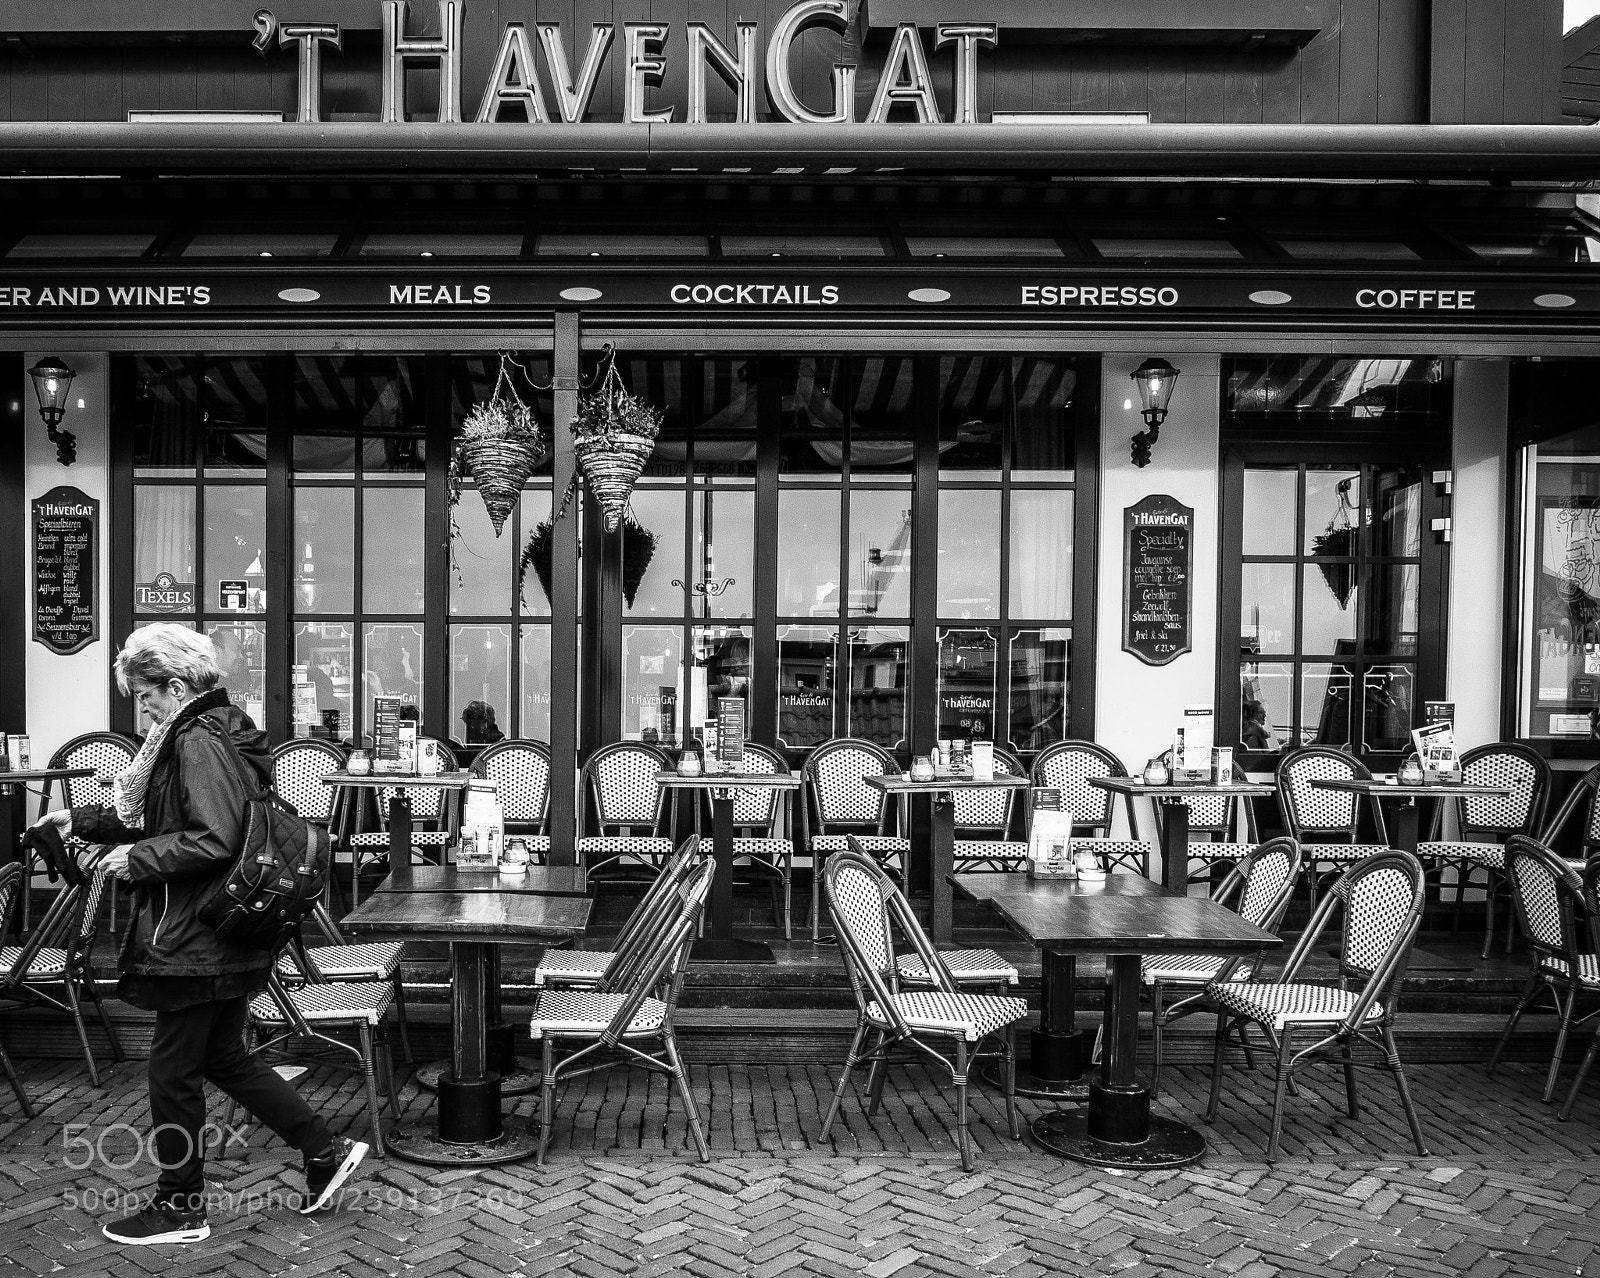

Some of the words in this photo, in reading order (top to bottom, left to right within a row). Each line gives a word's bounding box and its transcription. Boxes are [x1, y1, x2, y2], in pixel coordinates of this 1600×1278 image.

[36, 287, 100, 306] AND
[107, 286, 211, 305] WINE'S
[389, 285, 491, 304] MEALS
[670, 284, 839, 305] COCKTAILS
[1021, 286, 1179, 306] ESPRESSO
[1355, 289, 1476, 310] COFFEE
